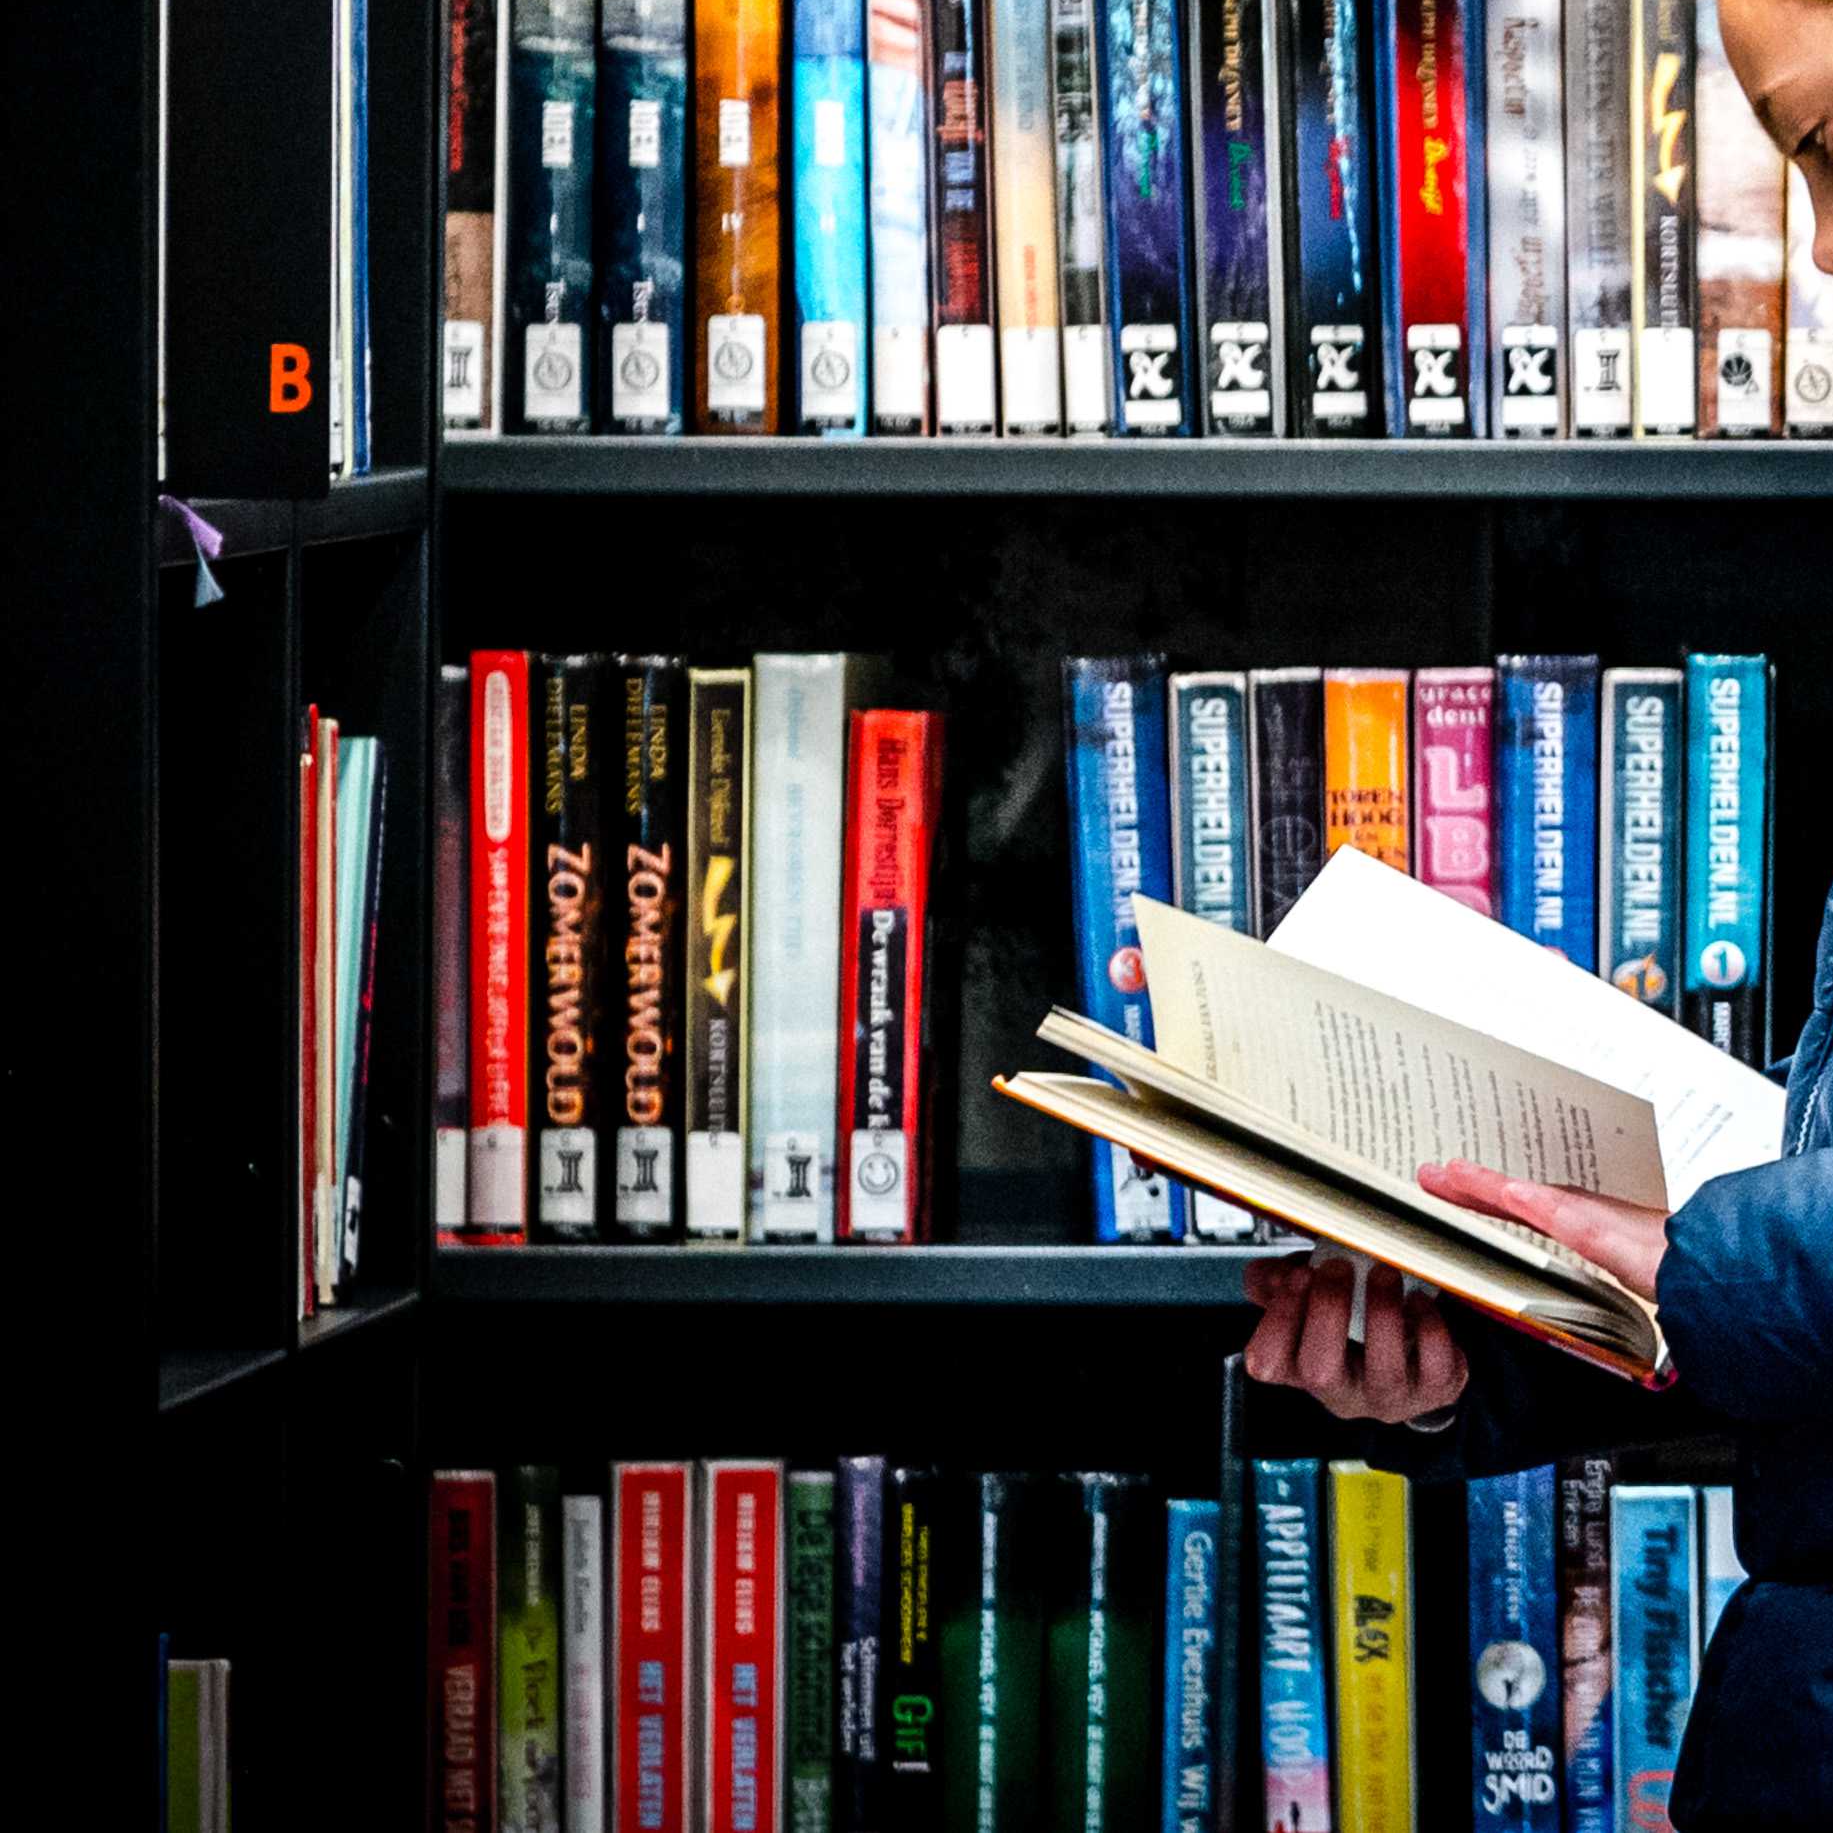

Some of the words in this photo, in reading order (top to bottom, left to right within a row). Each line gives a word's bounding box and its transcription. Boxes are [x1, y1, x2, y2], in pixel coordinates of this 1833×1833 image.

[269, 343, 314, 412] B
[569, 703, 587, 781] LINDA
[648, 703, 668, 781] LINDA
[1532, 681, 1564, 935] SUPERHELDEN.NL
[1622, 697, 1664, 949] SUPERHELDEN.NL
[1708, 677, 1741, 930] SUPERHELDEN.NL
[872, 910, 896, 938] De
[869, 941, 893, 1024] wraak
[869, 1030, 889, 1068] van
[867, 1076, 892, 1106] de
[1182, 1531, 1214, 1619] Gertie
[1635, 1526, 1679, 1600] Tiny
[1180, 1628, 1210, 1749] Evenhuis
